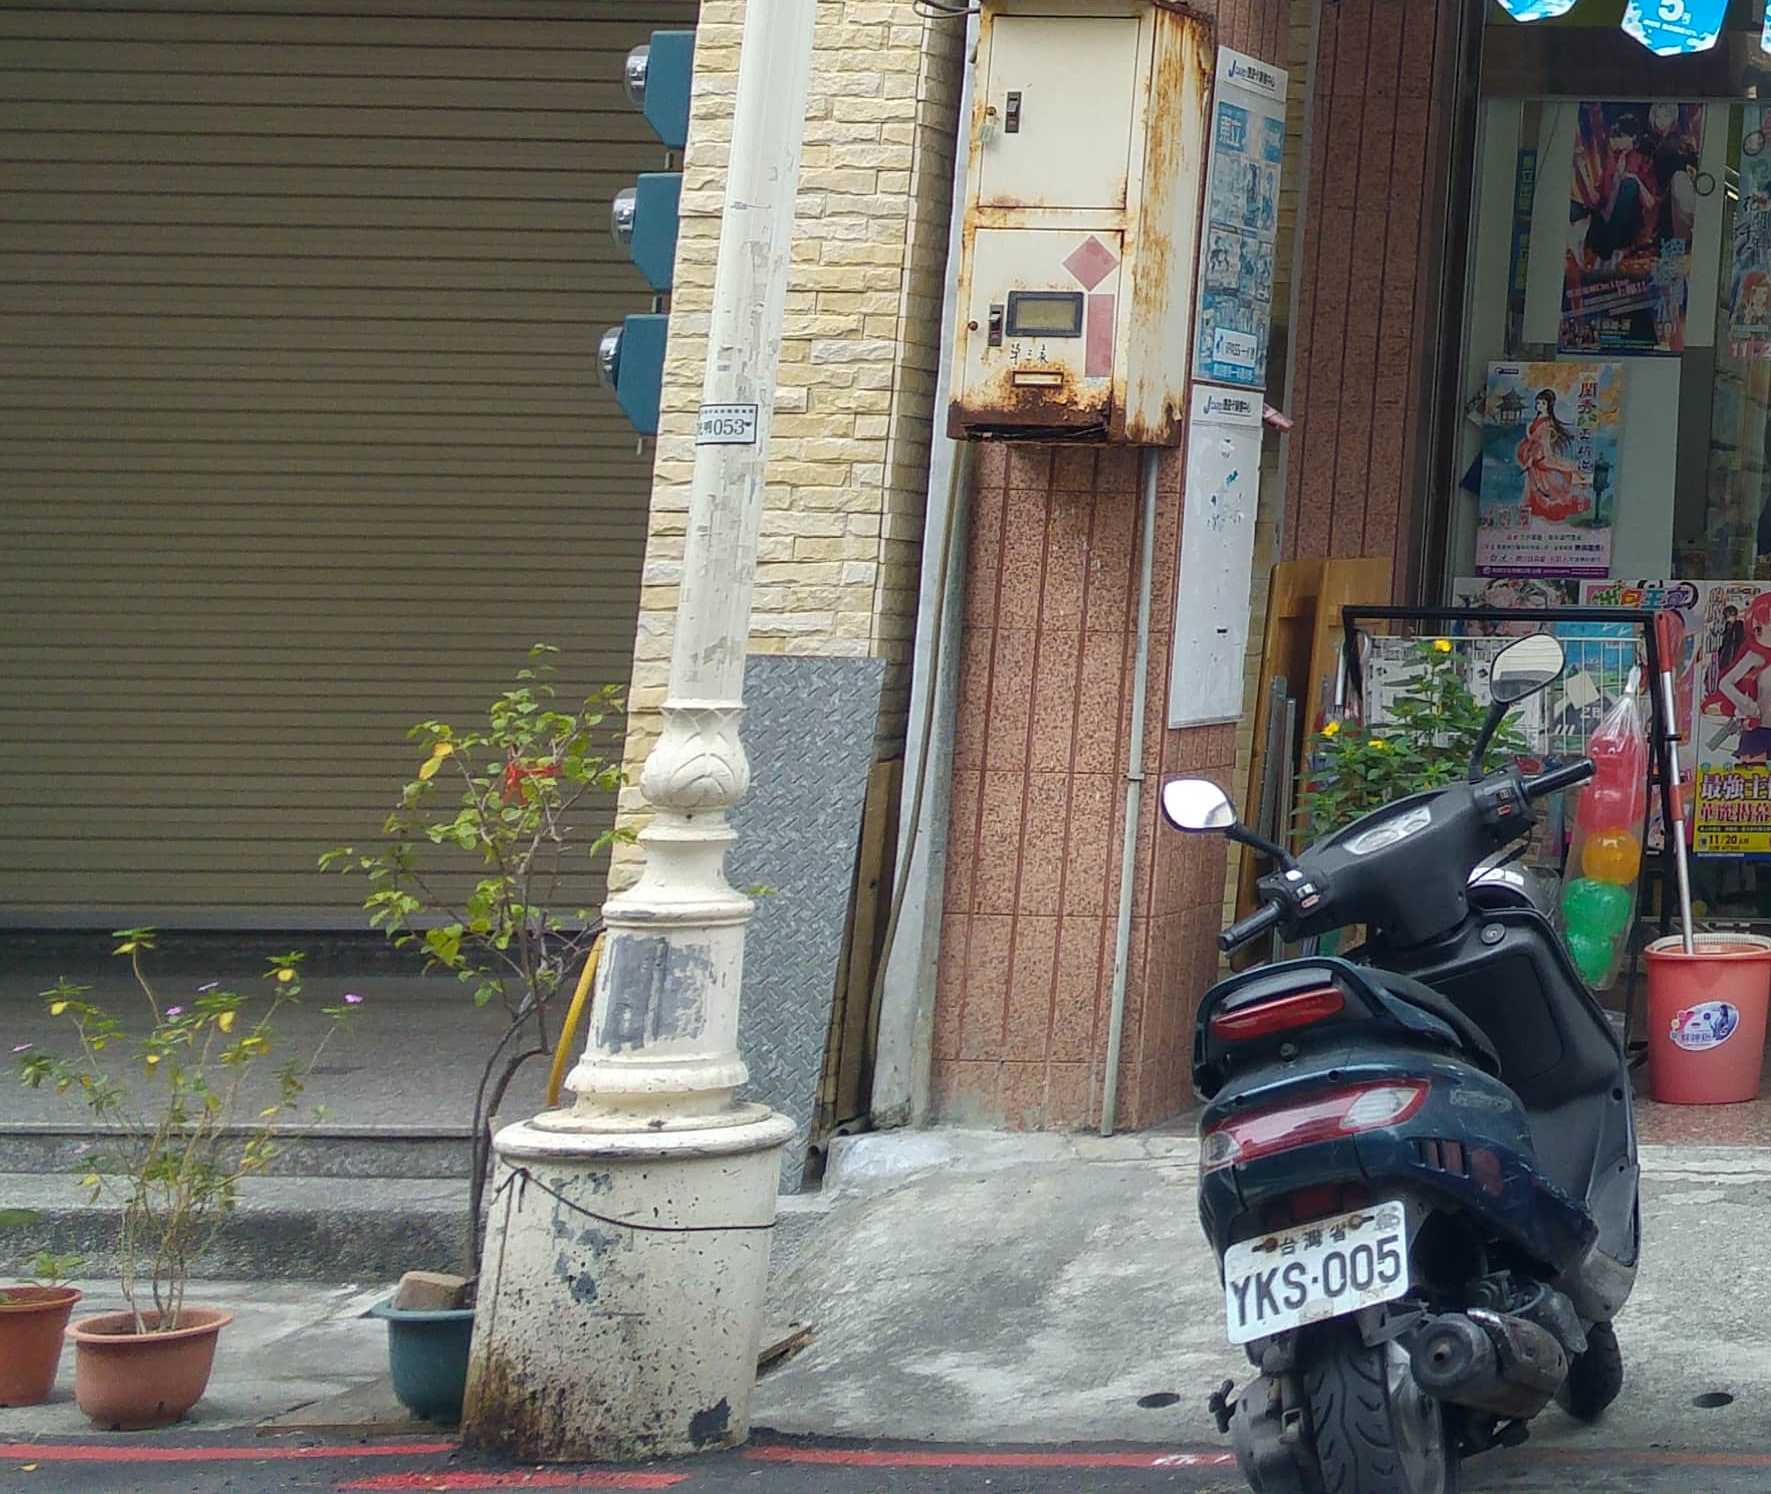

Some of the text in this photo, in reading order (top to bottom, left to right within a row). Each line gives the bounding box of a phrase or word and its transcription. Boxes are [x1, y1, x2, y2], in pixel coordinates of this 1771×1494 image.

[1279, 1223, 1348, 1257] 台灣省
[1228, 1234, 1402, 1327] YKS-005
